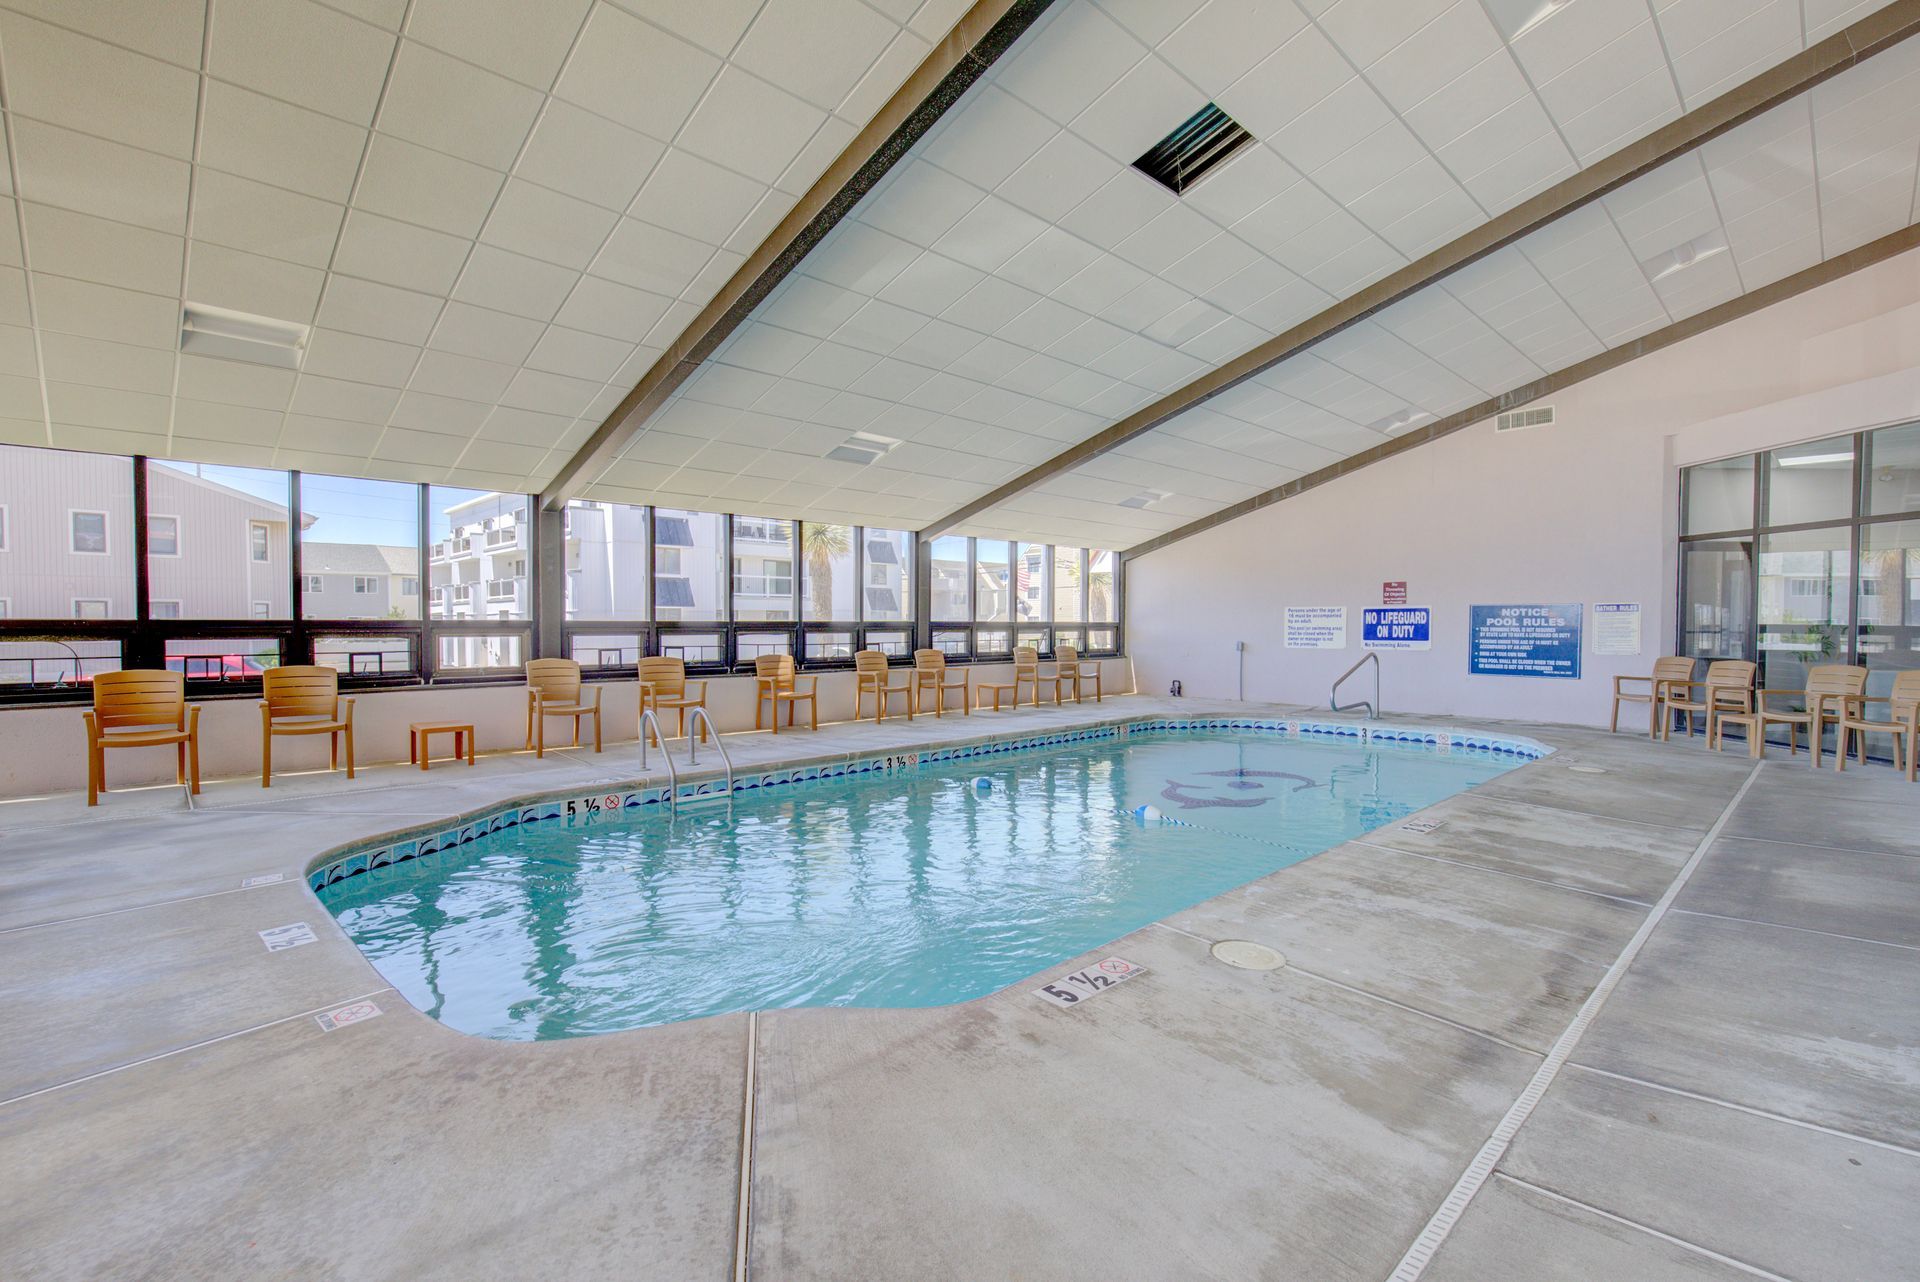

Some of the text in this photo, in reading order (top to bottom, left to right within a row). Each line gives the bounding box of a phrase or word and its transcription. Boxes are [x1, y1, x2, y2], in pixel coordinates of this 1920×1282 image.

[1366, 611, 1427, 624] NO LIFEGUARD
[1486, 618, 1566, 626] POOL RULES
[1377, 625, 1414, 638] ON DUTY
[1361, 728, 1368, 738] 3
[887, 757, 892, 768] 3
[567, 800, 576, 815] 5
[1042, 984, 1079, 1002] 5
